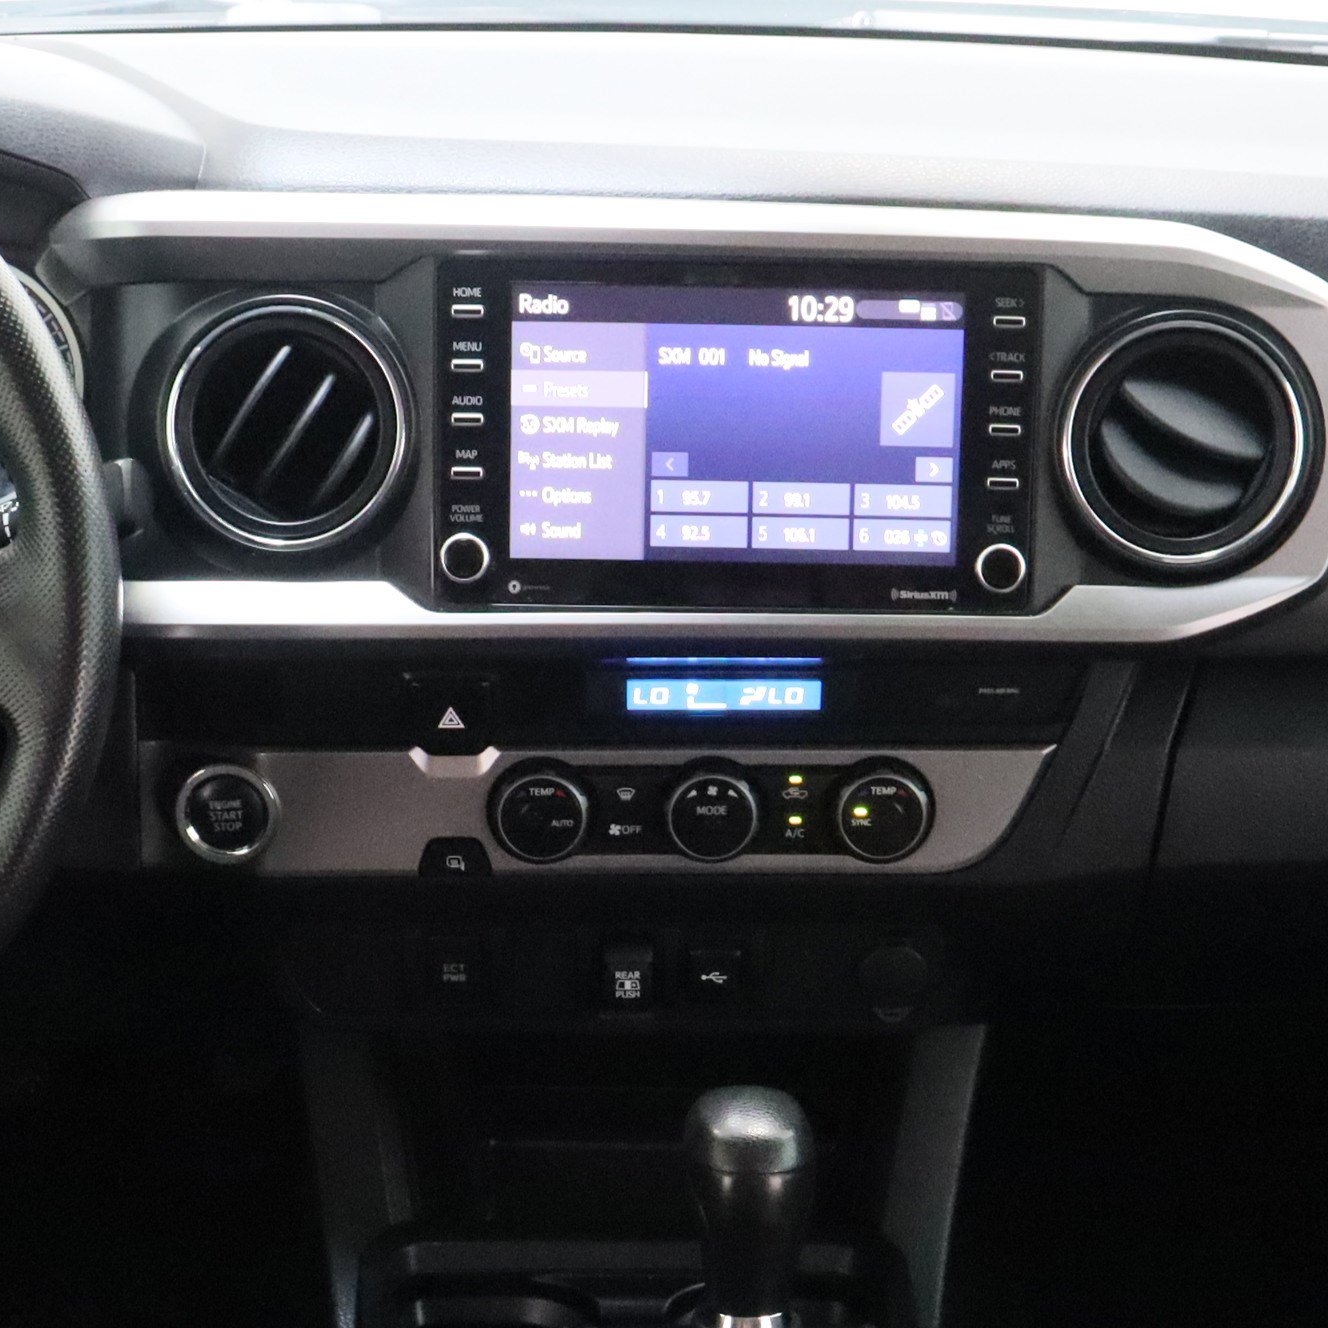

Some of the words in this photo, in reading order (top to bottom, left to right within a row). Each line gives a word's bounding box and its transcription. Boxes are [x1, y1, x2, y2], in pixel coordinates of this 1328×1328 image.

[453, 287, 482, 298] HOME
[519, 293, 570, 315] Radio
[788, 295, 855, 323] 10:29
[452, 341, 482, 351] MENU
[543, 345, 588, 363] Source
[657, 347, 692, 366] SXM
[698, 347, 726, 366] 001
[748, 348, 770, 367] No
[771, 348, 810, 370] Signal
[996, 351, 1026, 362] TRACK
[543, 381, 589, 398] Presets
[452, 396, 483, 406] AUDIO
[989, 406, 1021, 417] PHONE
[542, 416, 574, 433] SXM
[576, 416, 620, 438] Replay
[455, 450, 478, 459] MAP
[541, 451, 587, 469] Station
[589, 452, 613, 470] List
[991, 460, 1016, 470] APPS
[541, 486, 592, 507] Options
[657, 489, 665, 504] 1
[759, 490, 769, 507] 2
[860, 492, 870, 509] 3
[452, 505, 480, 513] POWER
[450, 514, 483, 523] VOLUME
[541, 521, 582, 539] Sound
[656, 524, 667, 540] 4
[758, 525, 768, 542] 5
[858, 527, 870, 543] 6
[633, 687, 670, 705] LO
[768, 687, 805, 705] LO
[529, 787, 555, 797] TEMP
[871, 786, 897, 796] TEMP
[209, 810, 243, 820] START
[696, 806, 728, 816] MODE
[213, 822, 243, 832] STOP
[551, 819, 573, 828] AUTO
[851, 819, 871, 828] SYNC
[622, 825, 642, 834] OFF
[785, 828, 805, 839] A/C
[443, 964, 465, 973] ECT
[615, 971, 640, 980] REAR
[616, 990, 640, 998] PUSH
